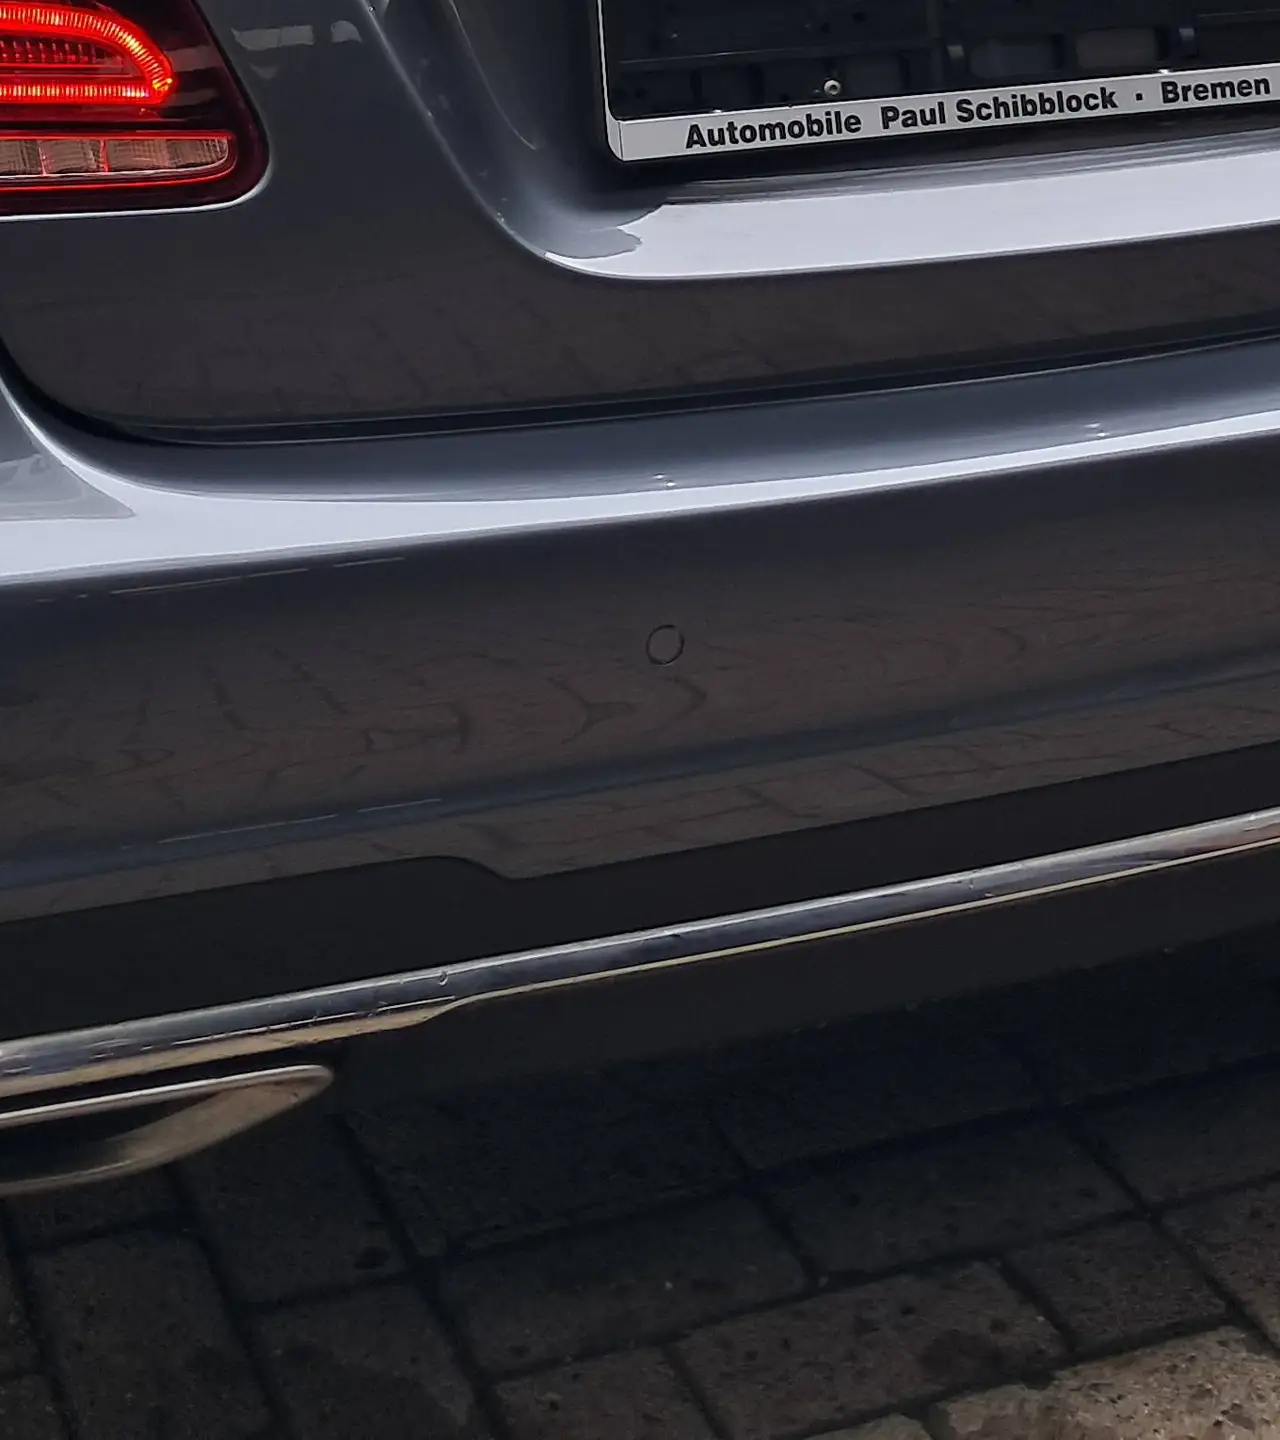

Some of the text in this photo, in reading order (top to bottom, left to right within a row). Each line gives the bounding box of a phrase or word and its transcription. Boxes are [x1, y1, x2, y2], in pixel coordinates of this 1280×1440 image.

[685, 110, 863, 150] Automobile
[880, 101, 946, 130] Paul
[956, 88, 1118, 124] Schibblock
[1161, 76, 1271, 105] Bremen
